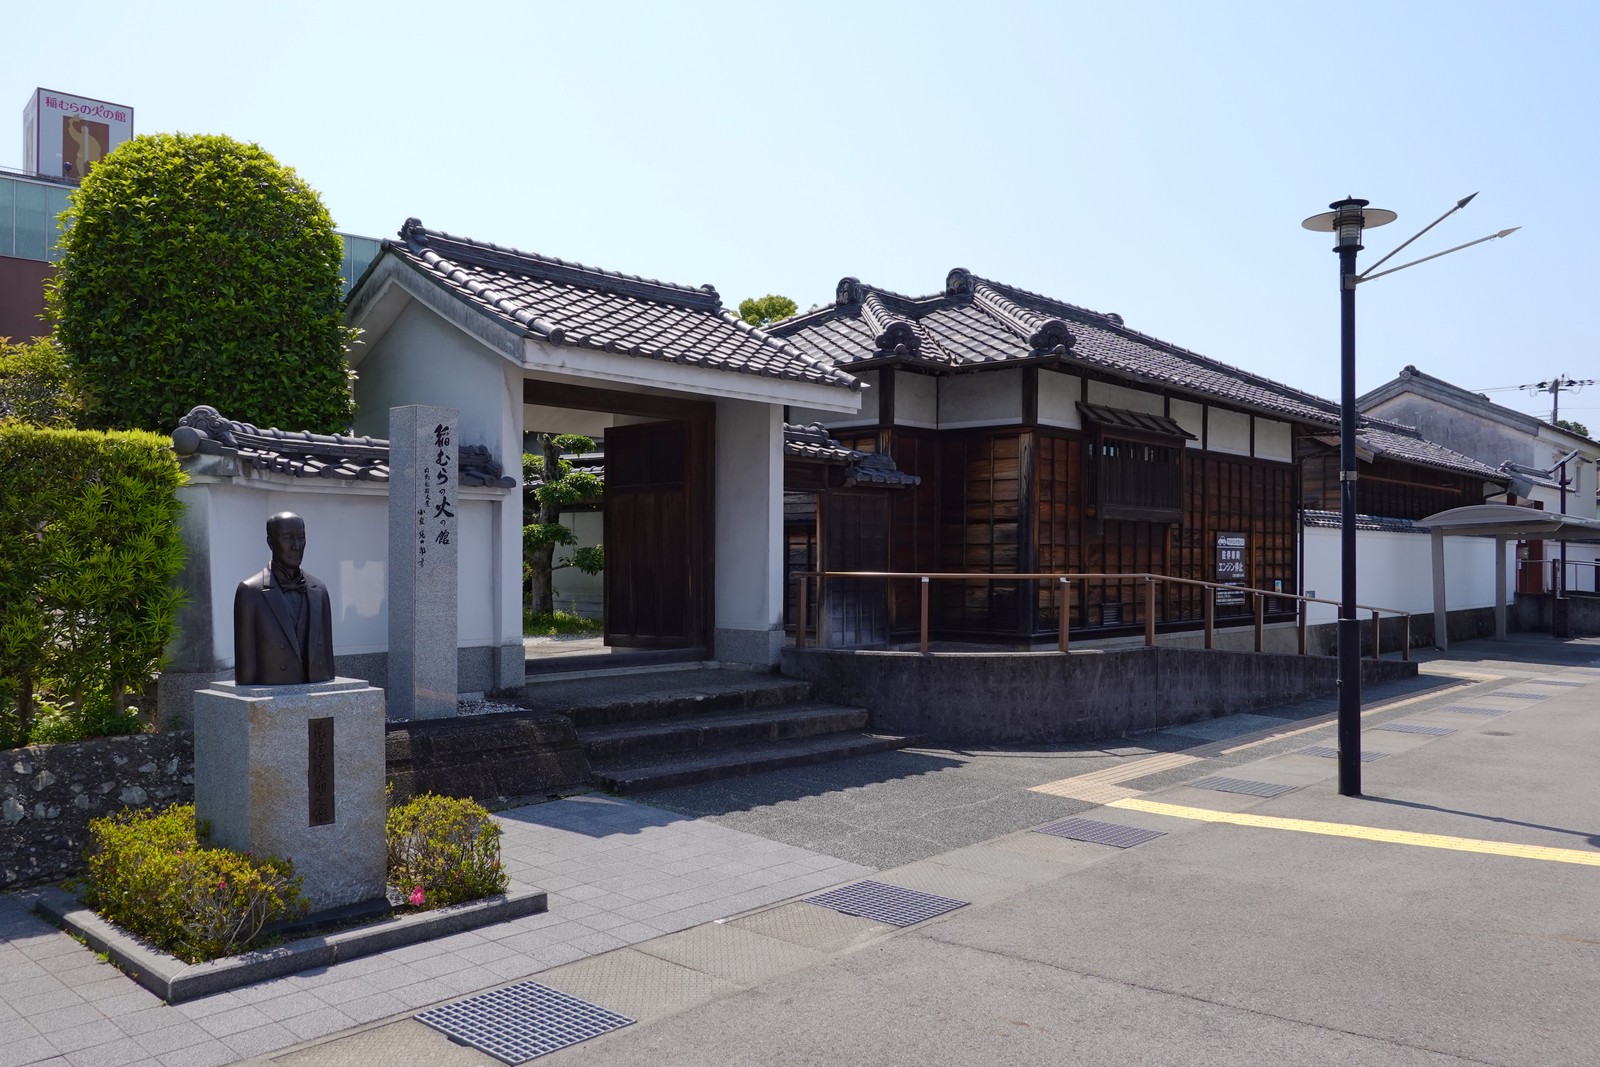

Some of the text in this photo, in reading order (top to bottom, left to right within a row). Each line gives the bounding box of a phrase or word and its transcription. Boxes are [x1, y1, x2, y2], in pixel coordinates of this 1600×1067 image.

[45, 96, 126, 122] 稲むらの火の館
[434, 423, 455, 545] 稲むらの火の館
